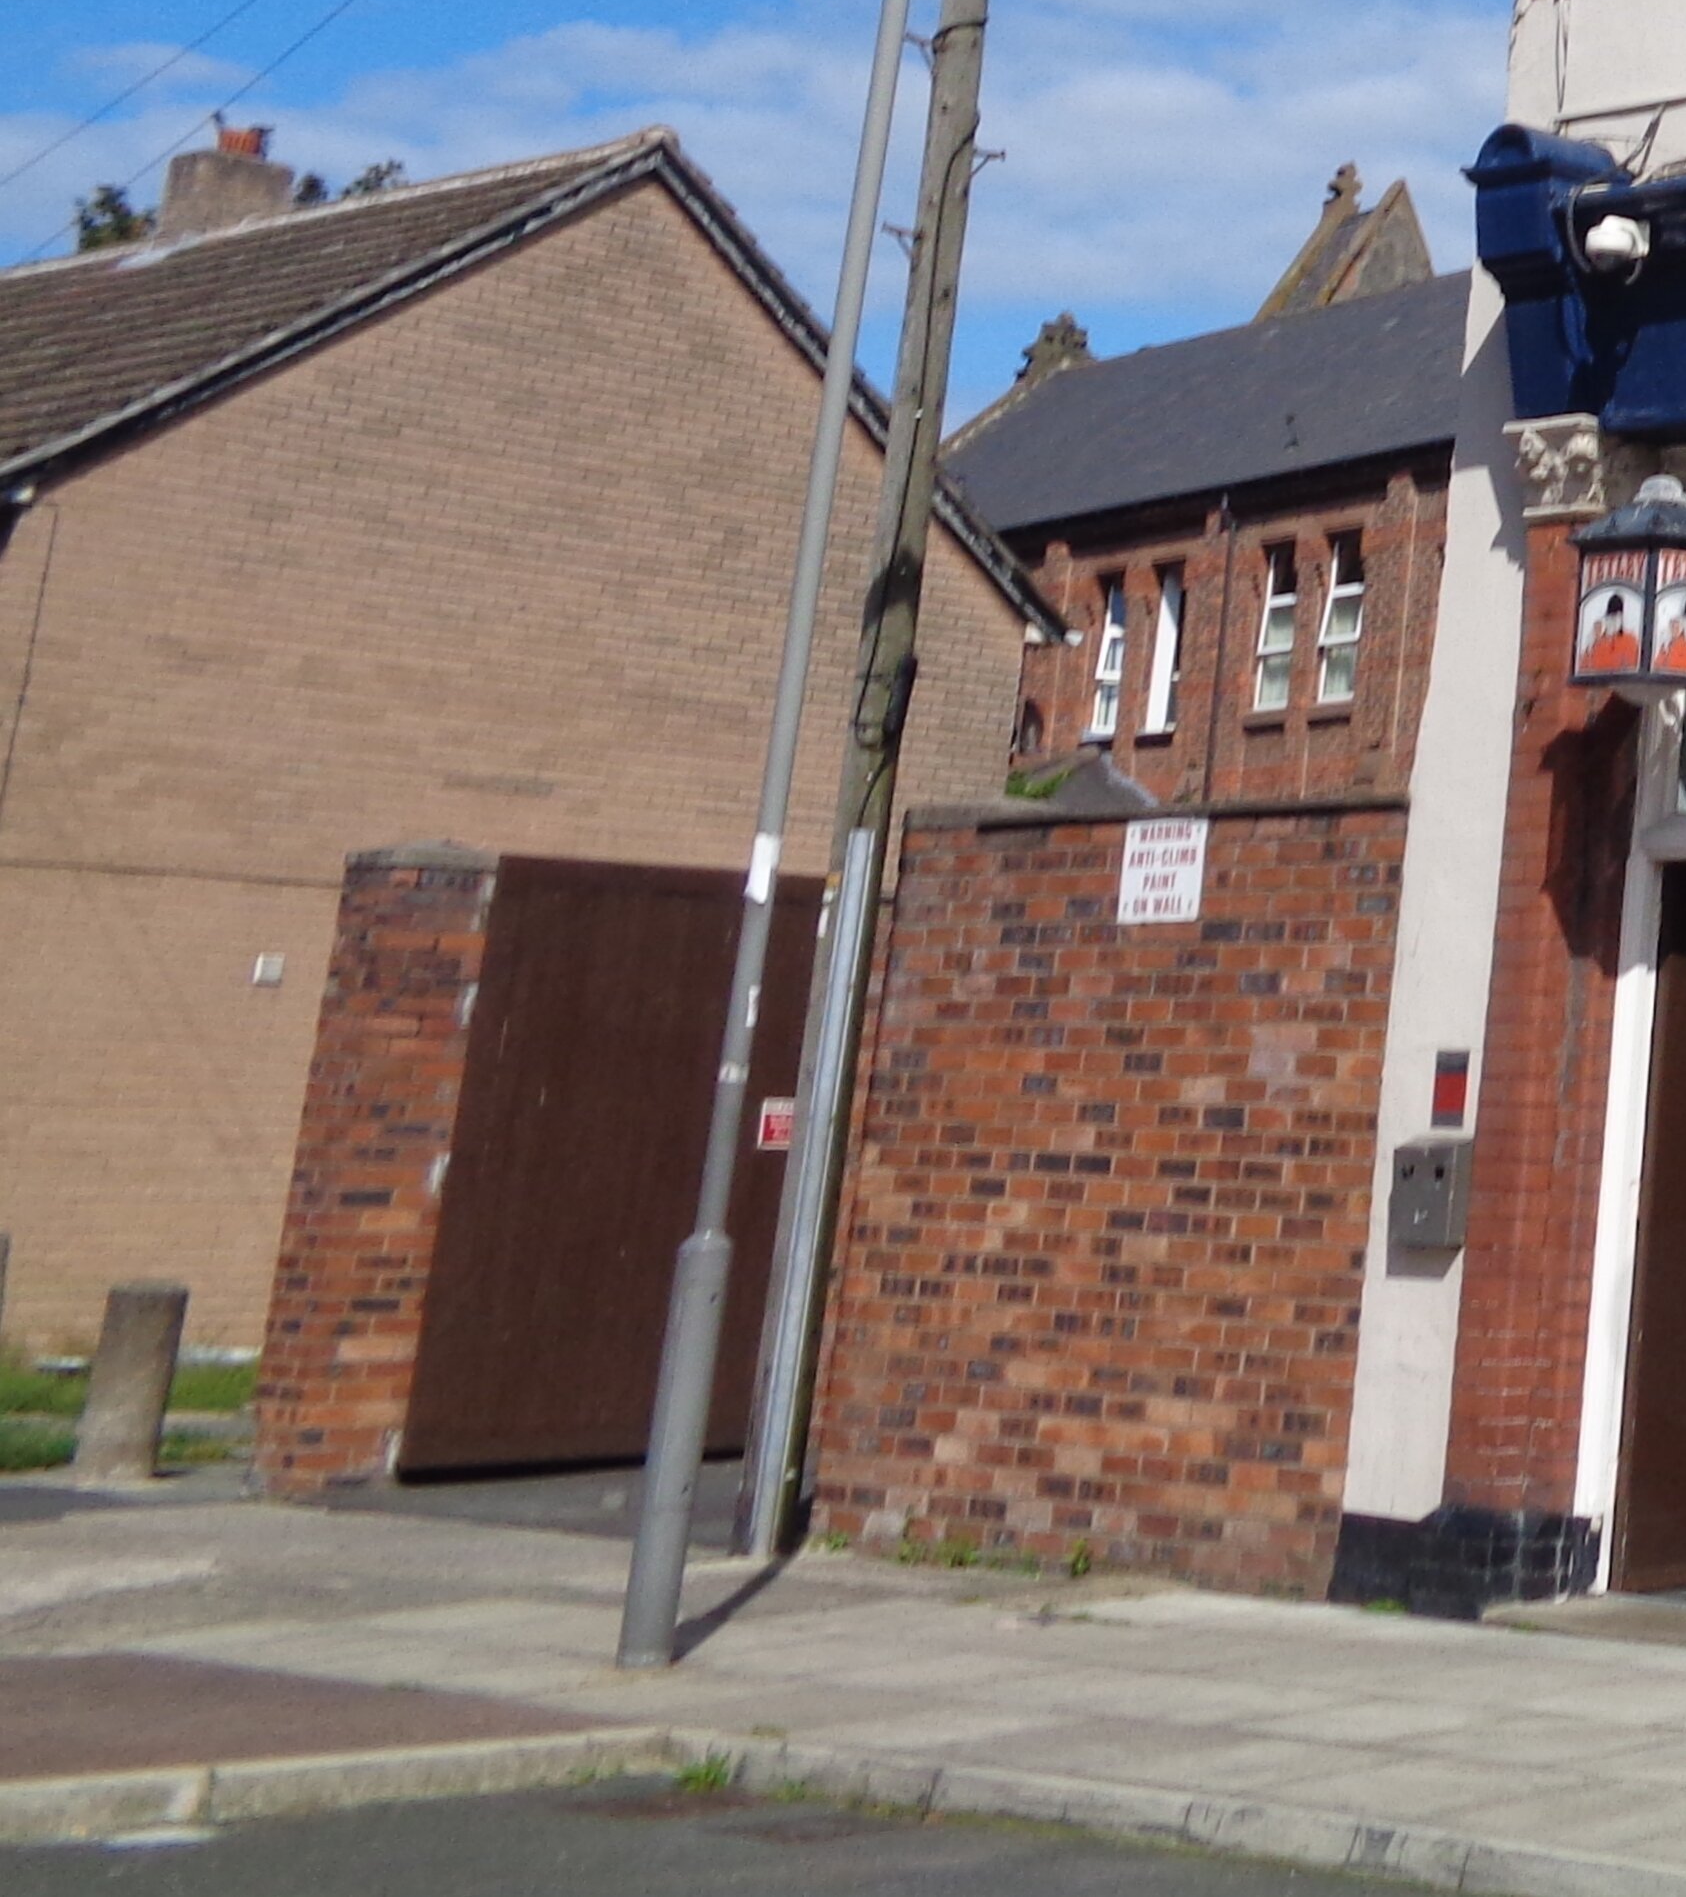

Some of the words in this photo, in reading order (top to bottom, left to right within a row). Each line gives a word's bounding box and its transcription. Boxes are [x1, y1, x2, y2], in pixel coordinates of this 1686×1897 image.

[1139, 822, 1193, 842] WARNING
[1142, 871, 1177, 892] PAINT
[1133, 896, 1149, 916] ON
[1153, 894, 1182, 915] WALL
